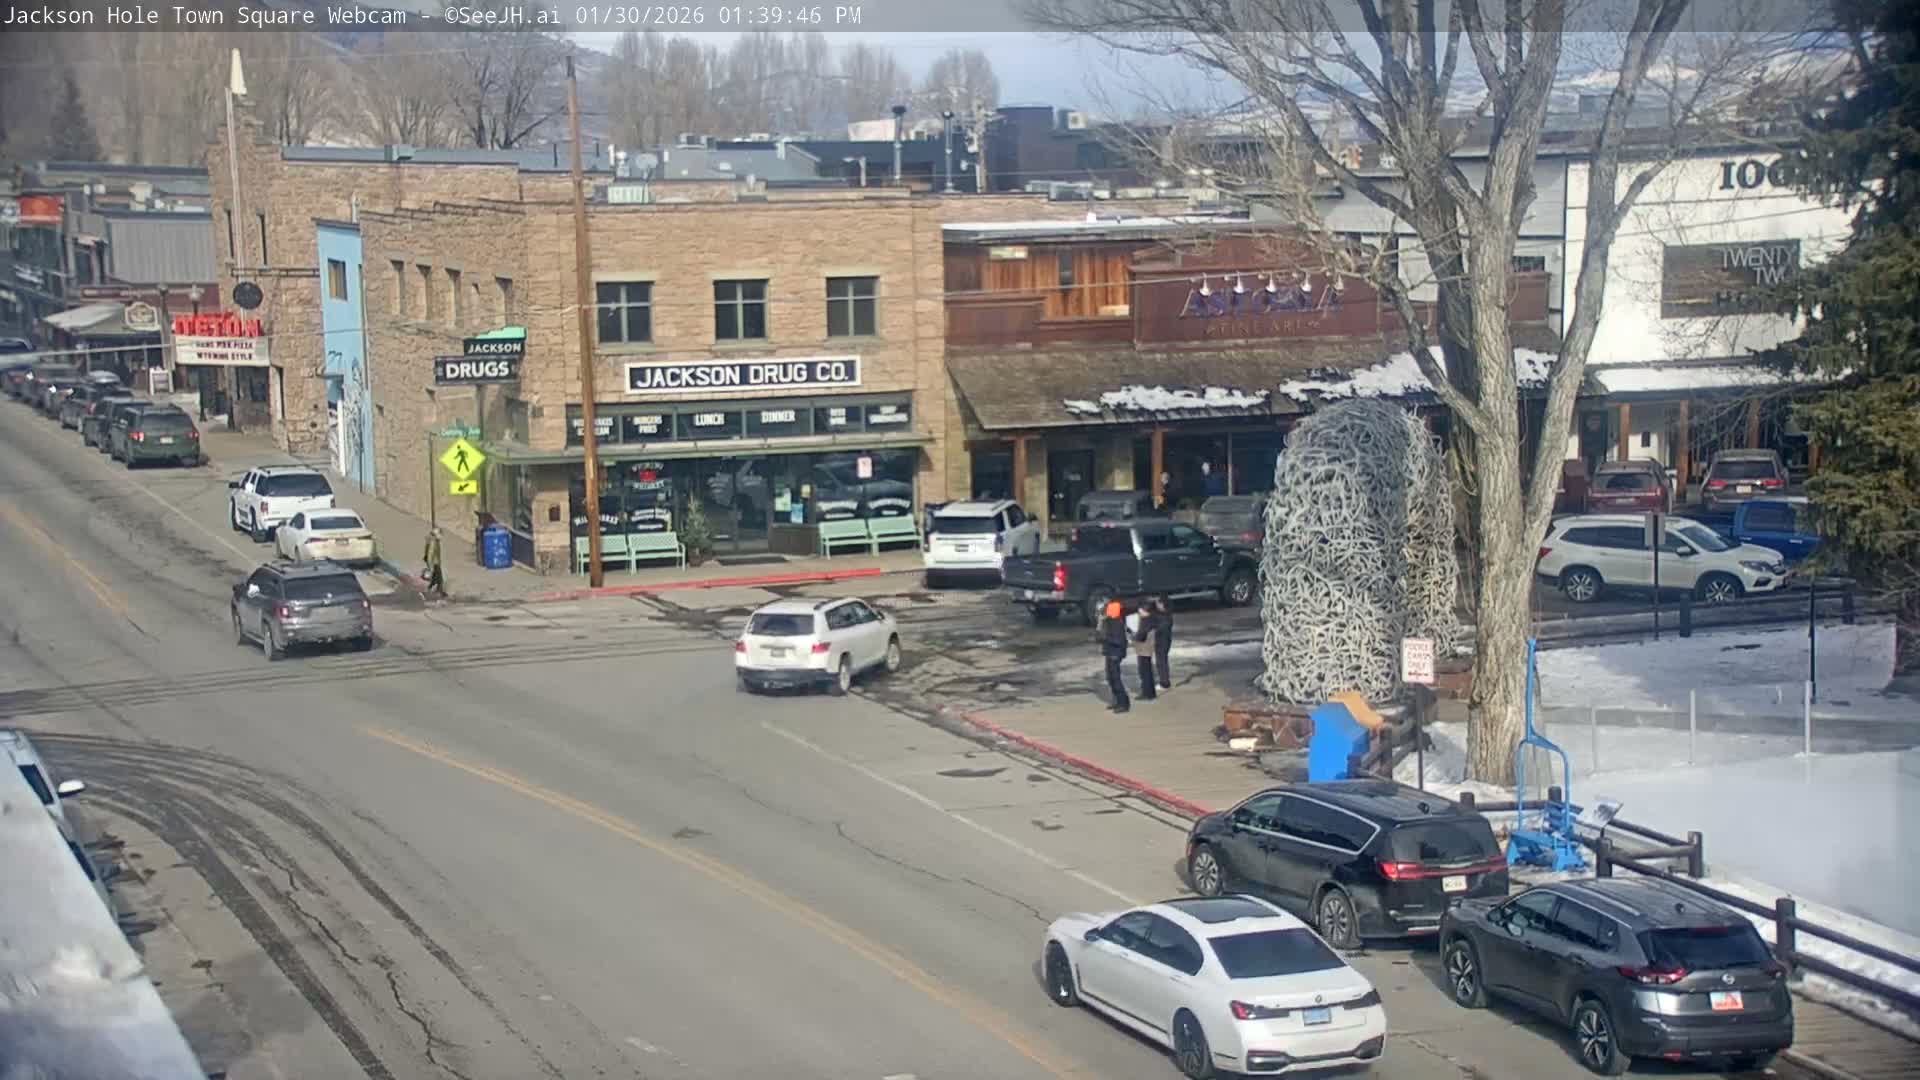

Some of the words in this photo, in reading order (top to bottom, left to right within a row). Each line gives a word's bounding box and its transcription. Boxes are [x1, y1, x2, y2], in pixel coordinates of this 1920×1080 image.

[1717, 246, 1793, 269] TWENTY
[174, 314, 263, 337] TETON
[468, 343, 521, 354] JACKSON
[446, 361, 510, 379] DRUGS
[637, 365, 740, 388] JACKSON
[750, 363, 808, 384] DRUG
[816, 362, 849, 381] CO.
[694, 413, 725, 426] LUNCH
[761, 410, 796, 423] DINNER
